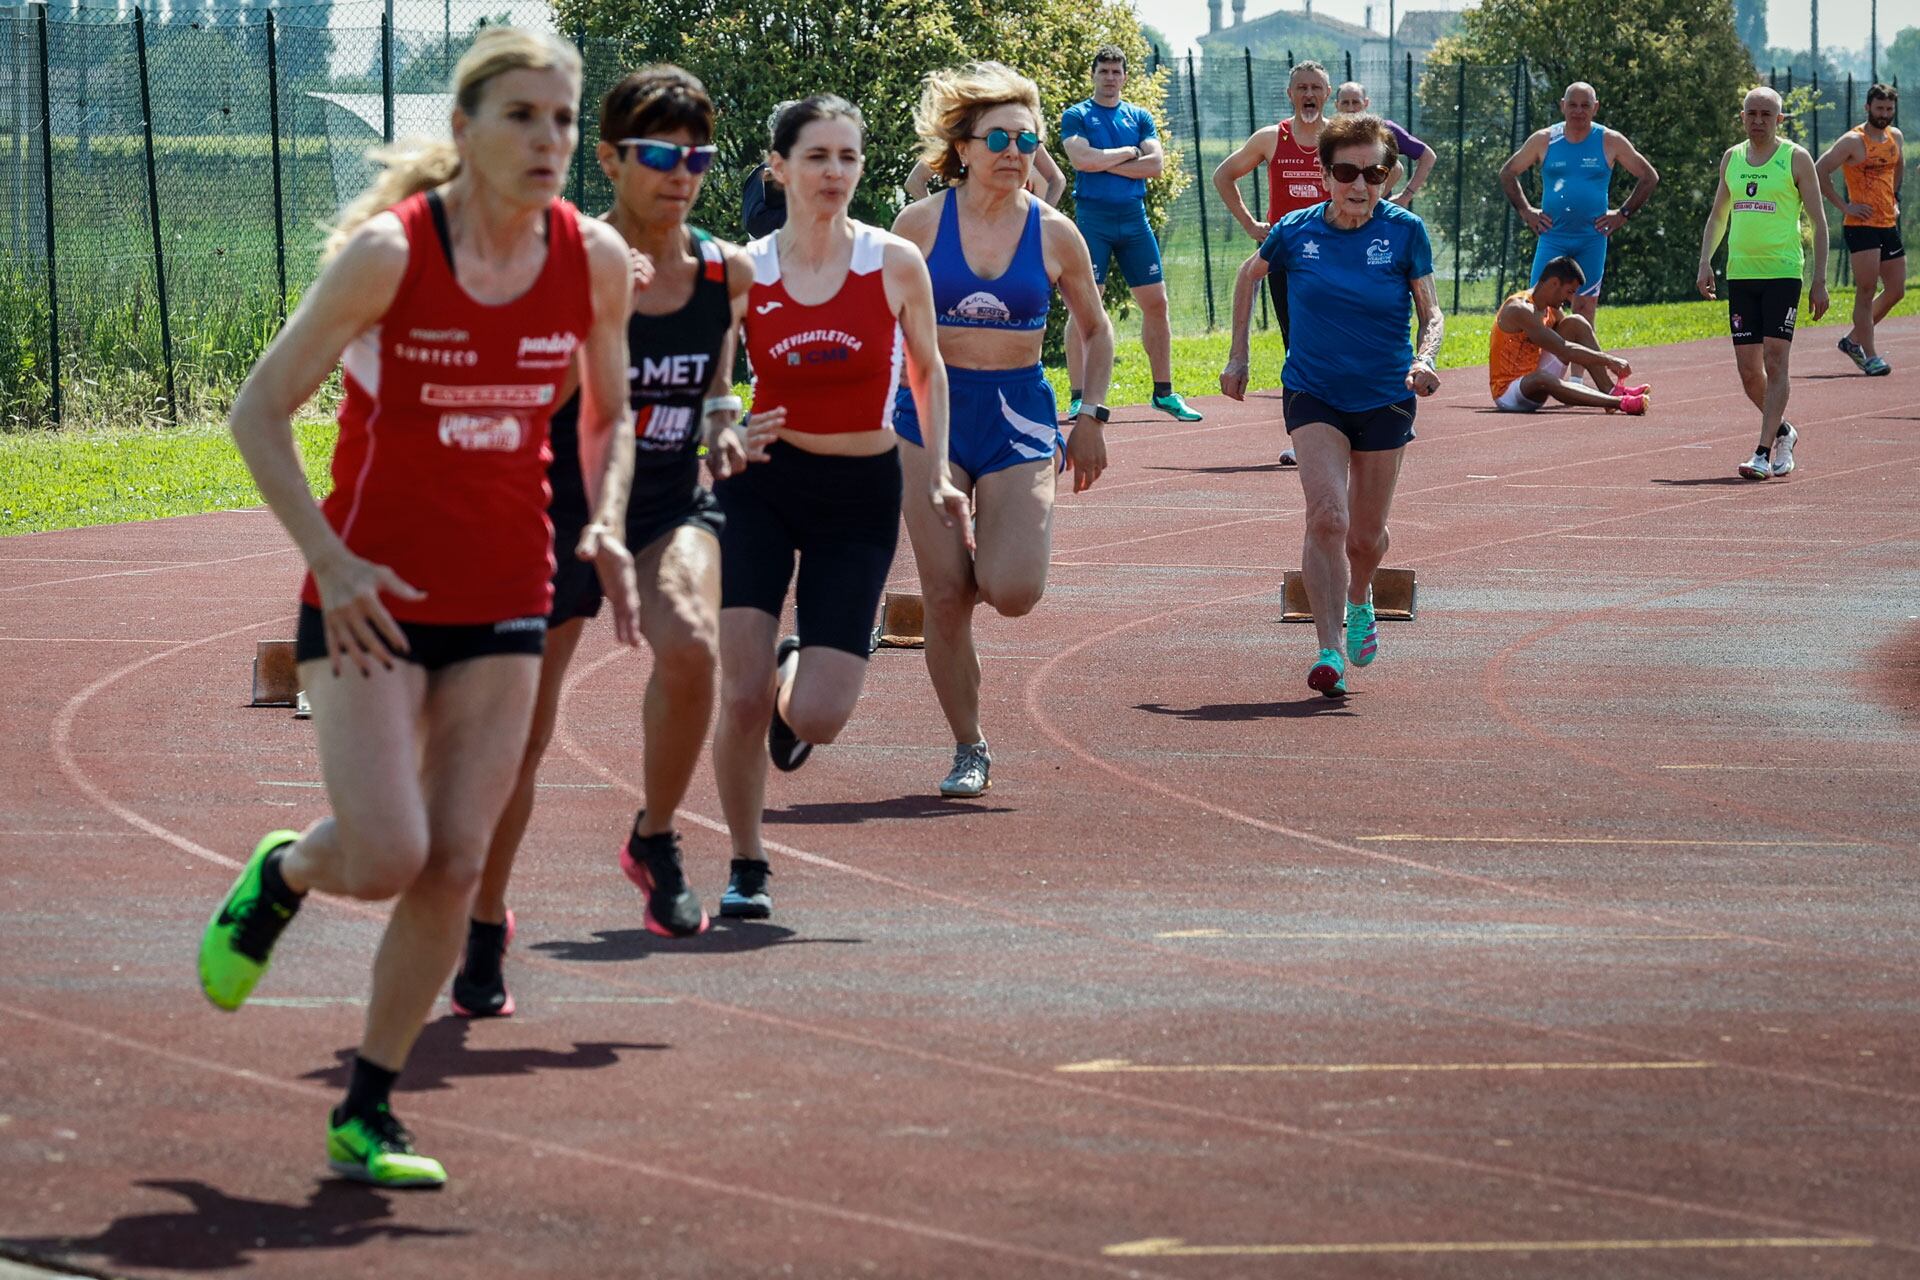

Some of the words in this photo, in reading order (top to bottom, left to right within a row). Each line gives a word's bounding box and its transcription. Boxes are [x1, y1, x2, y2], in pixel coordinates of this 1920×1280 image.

[939, 314, 979, 325] NIKE
[394, 342, 478, 367] SURTECO
[768, 329, 863, 360] TREVISATLETICA
